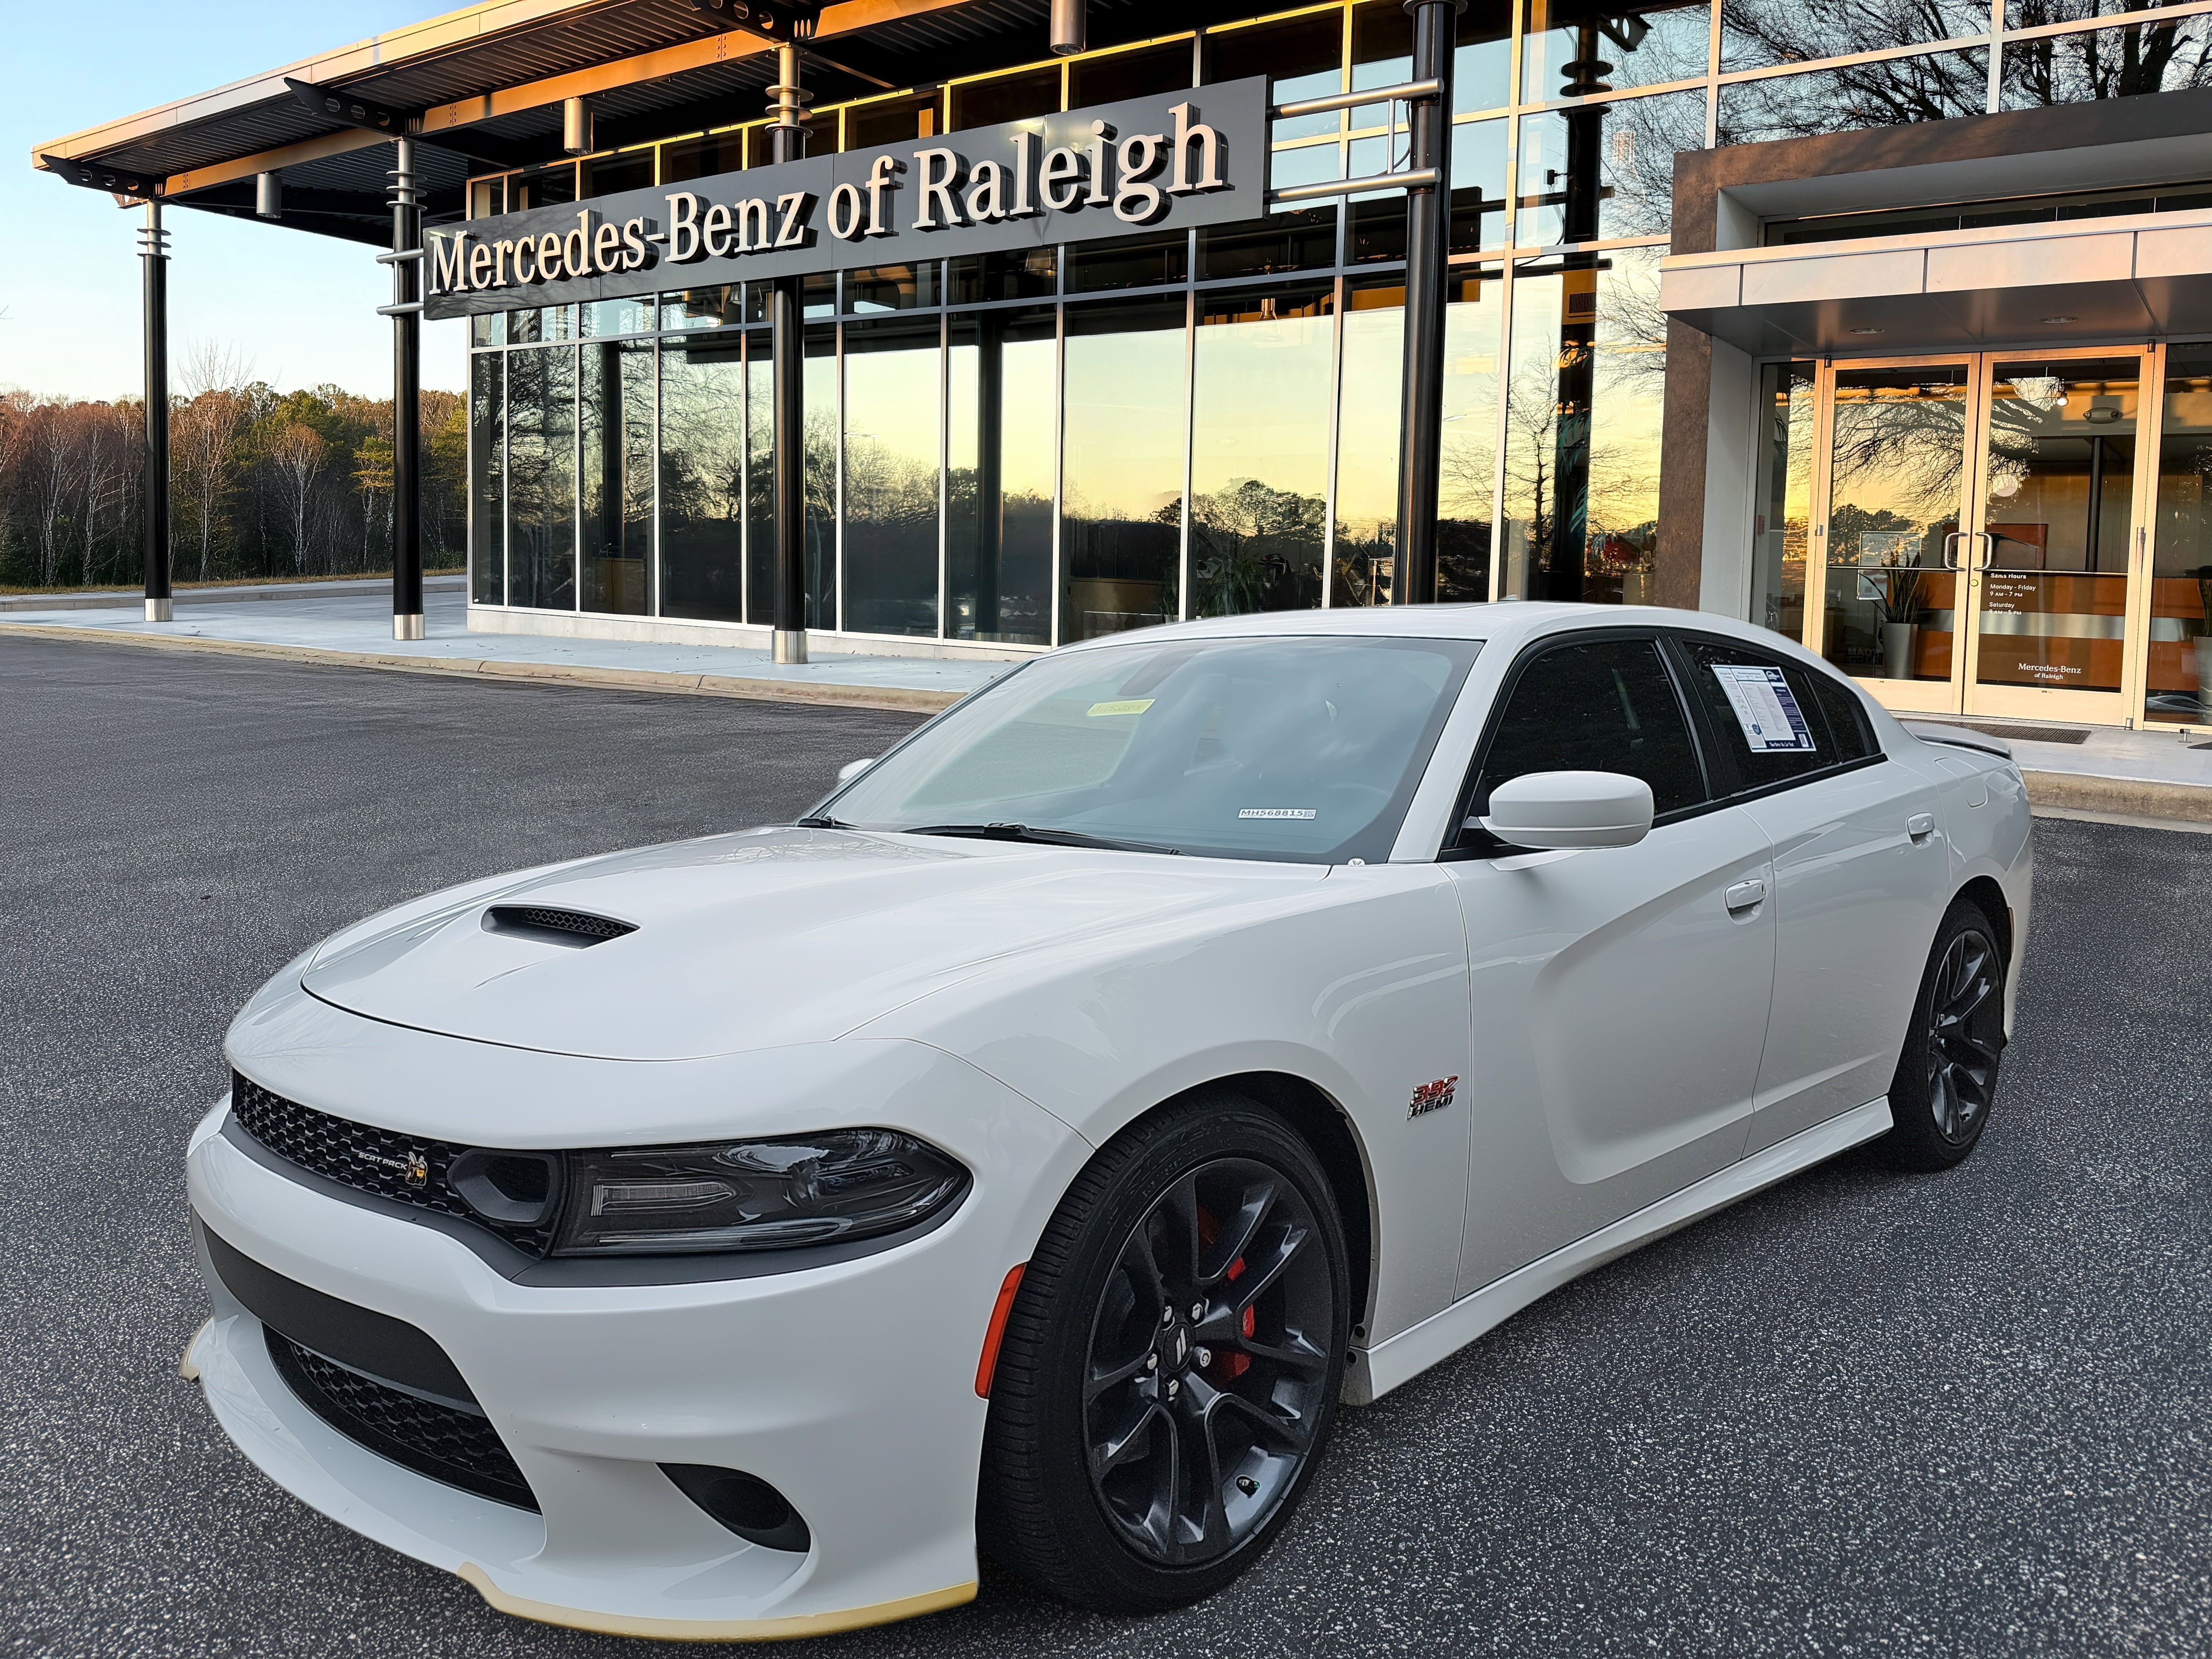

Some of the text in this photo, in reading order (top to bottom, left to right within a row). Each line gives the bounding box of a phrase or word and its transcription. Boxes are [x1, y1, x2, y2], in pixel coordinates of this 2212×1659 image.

[428, 101, 1224, 294] Mercedes-Benz of Raleigh
[2018, 663, 2081, 674] Mercedes-Benz
[1410, 1075, 1459, 1106] 392
[1407, 1094, 1455, 1121] HEMI
[358, 1151, 408, 1171] SCAT PACK
